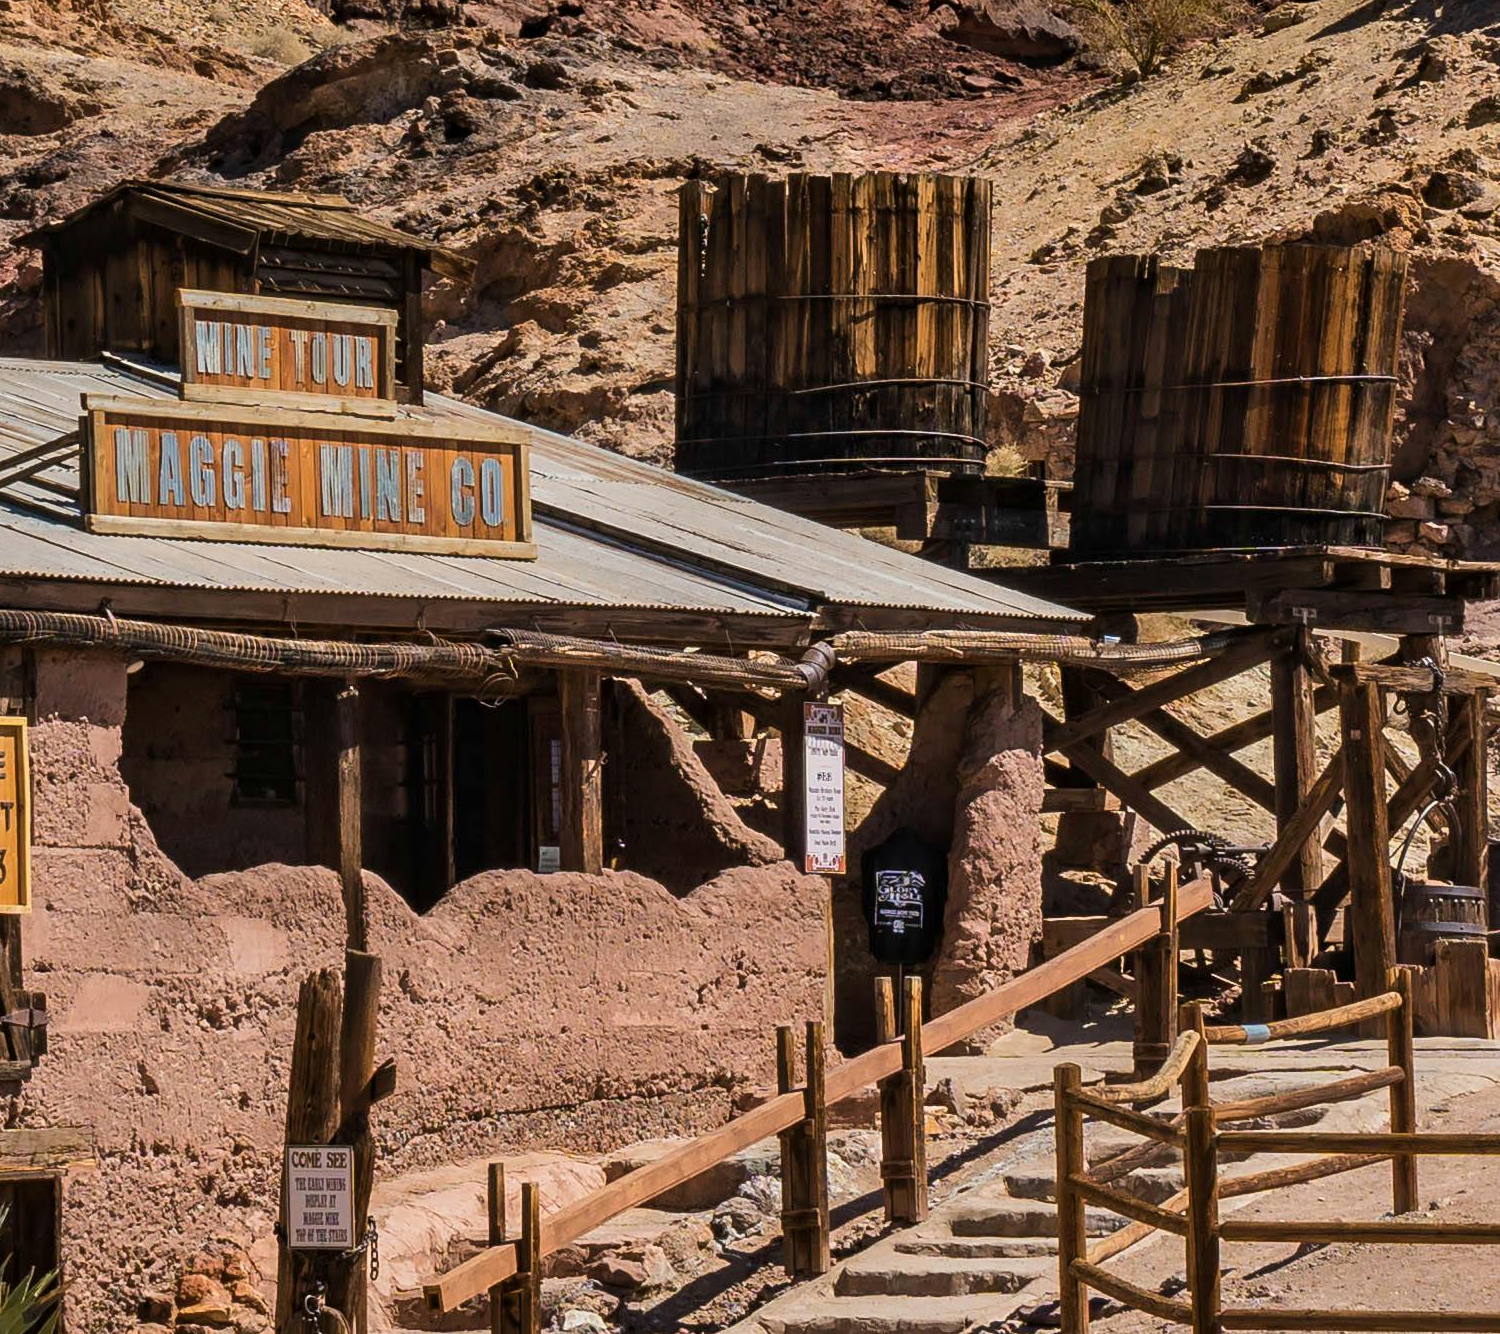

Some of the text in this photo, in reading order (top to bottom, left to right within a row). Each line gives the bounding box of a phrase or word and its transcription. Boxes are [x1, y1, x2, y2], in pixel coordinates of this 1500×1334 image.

[196, 320, 374, 389] MINE TOUR
[114, 427, 292, 514] MAGGIE
[319, 442, 425, 524] MINE
[291, 1151, 347, 1169] COME SEE
[295, 1177, 306, 1191] THE
